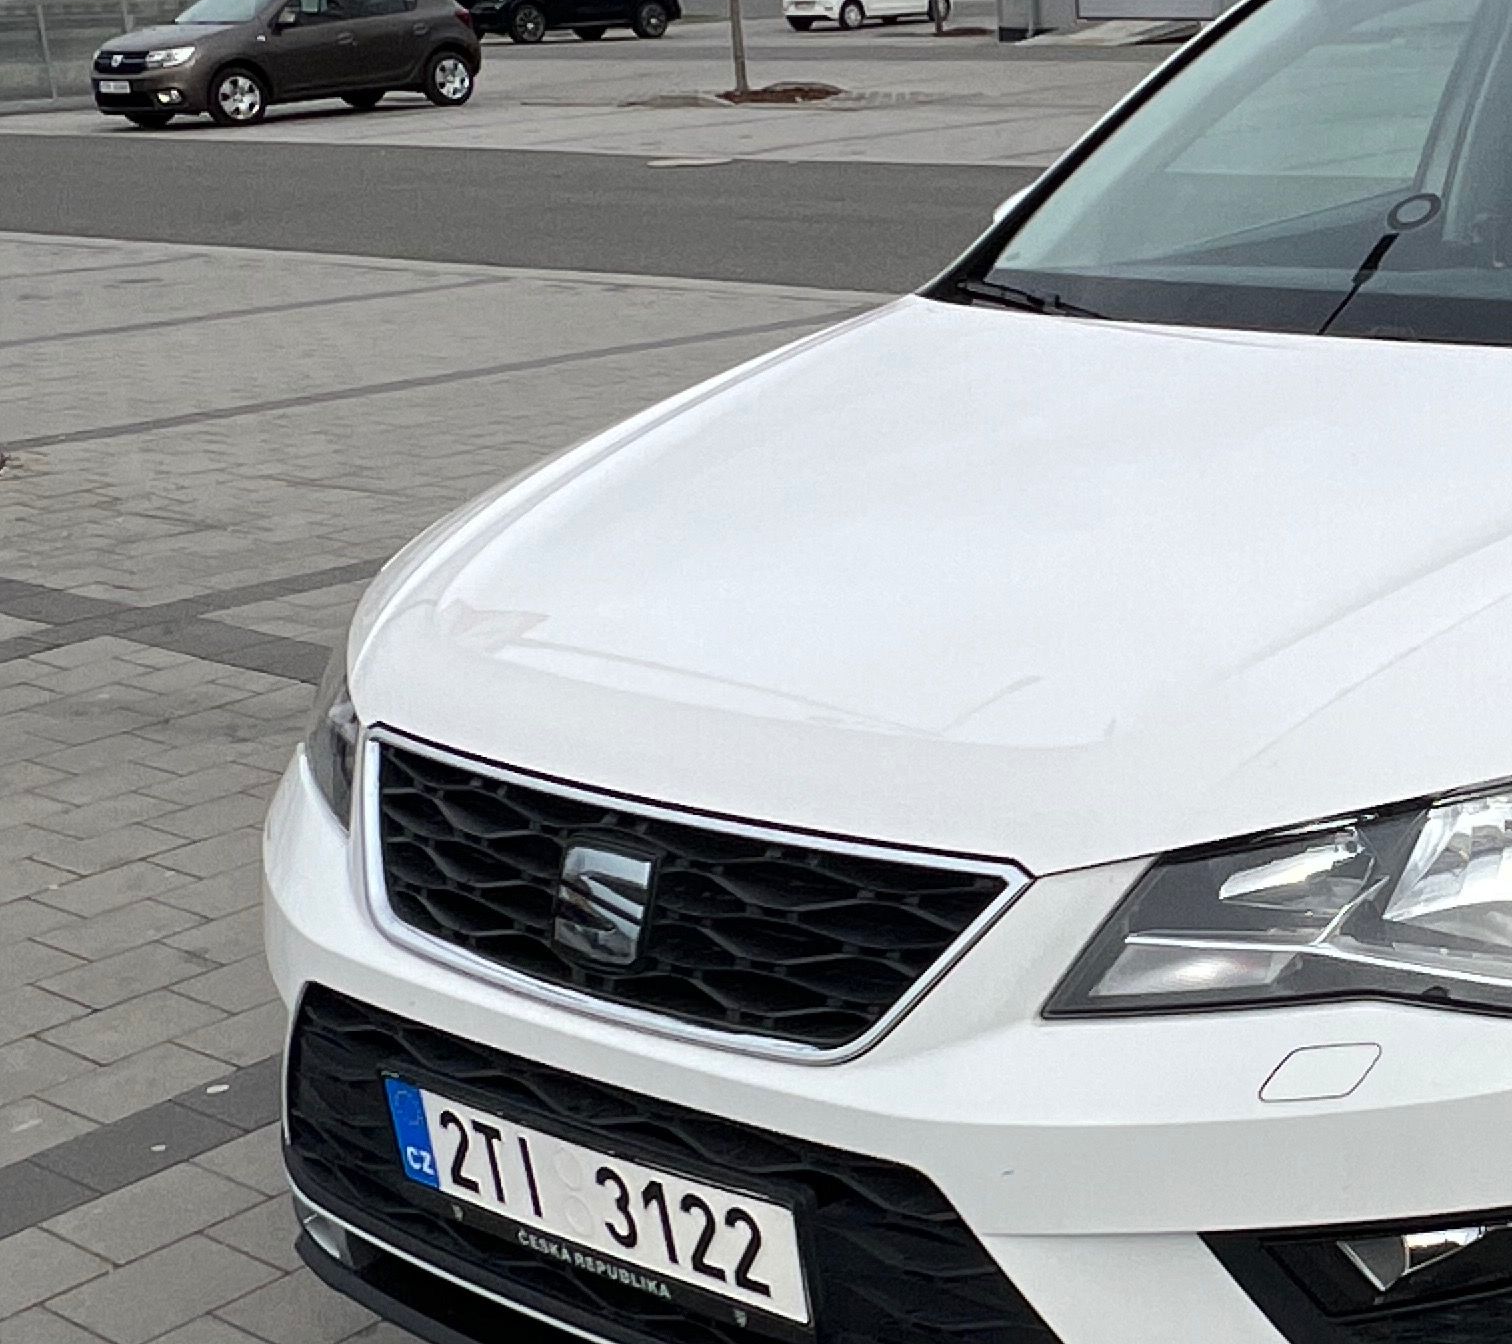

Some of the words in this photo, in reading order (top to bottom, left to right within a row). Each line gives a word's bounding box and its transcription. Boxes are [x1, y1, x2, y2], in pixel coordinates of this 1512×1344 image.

[406, 1146, 434, 1175] CZ
[440, 1110, 543, 1219] 2TI
[595, 1166, 772, 1298] 3122
[518, 1228, 572, 1264] ČESKÁ
[574, 1252, 672, 1300] REPUBLIKA
